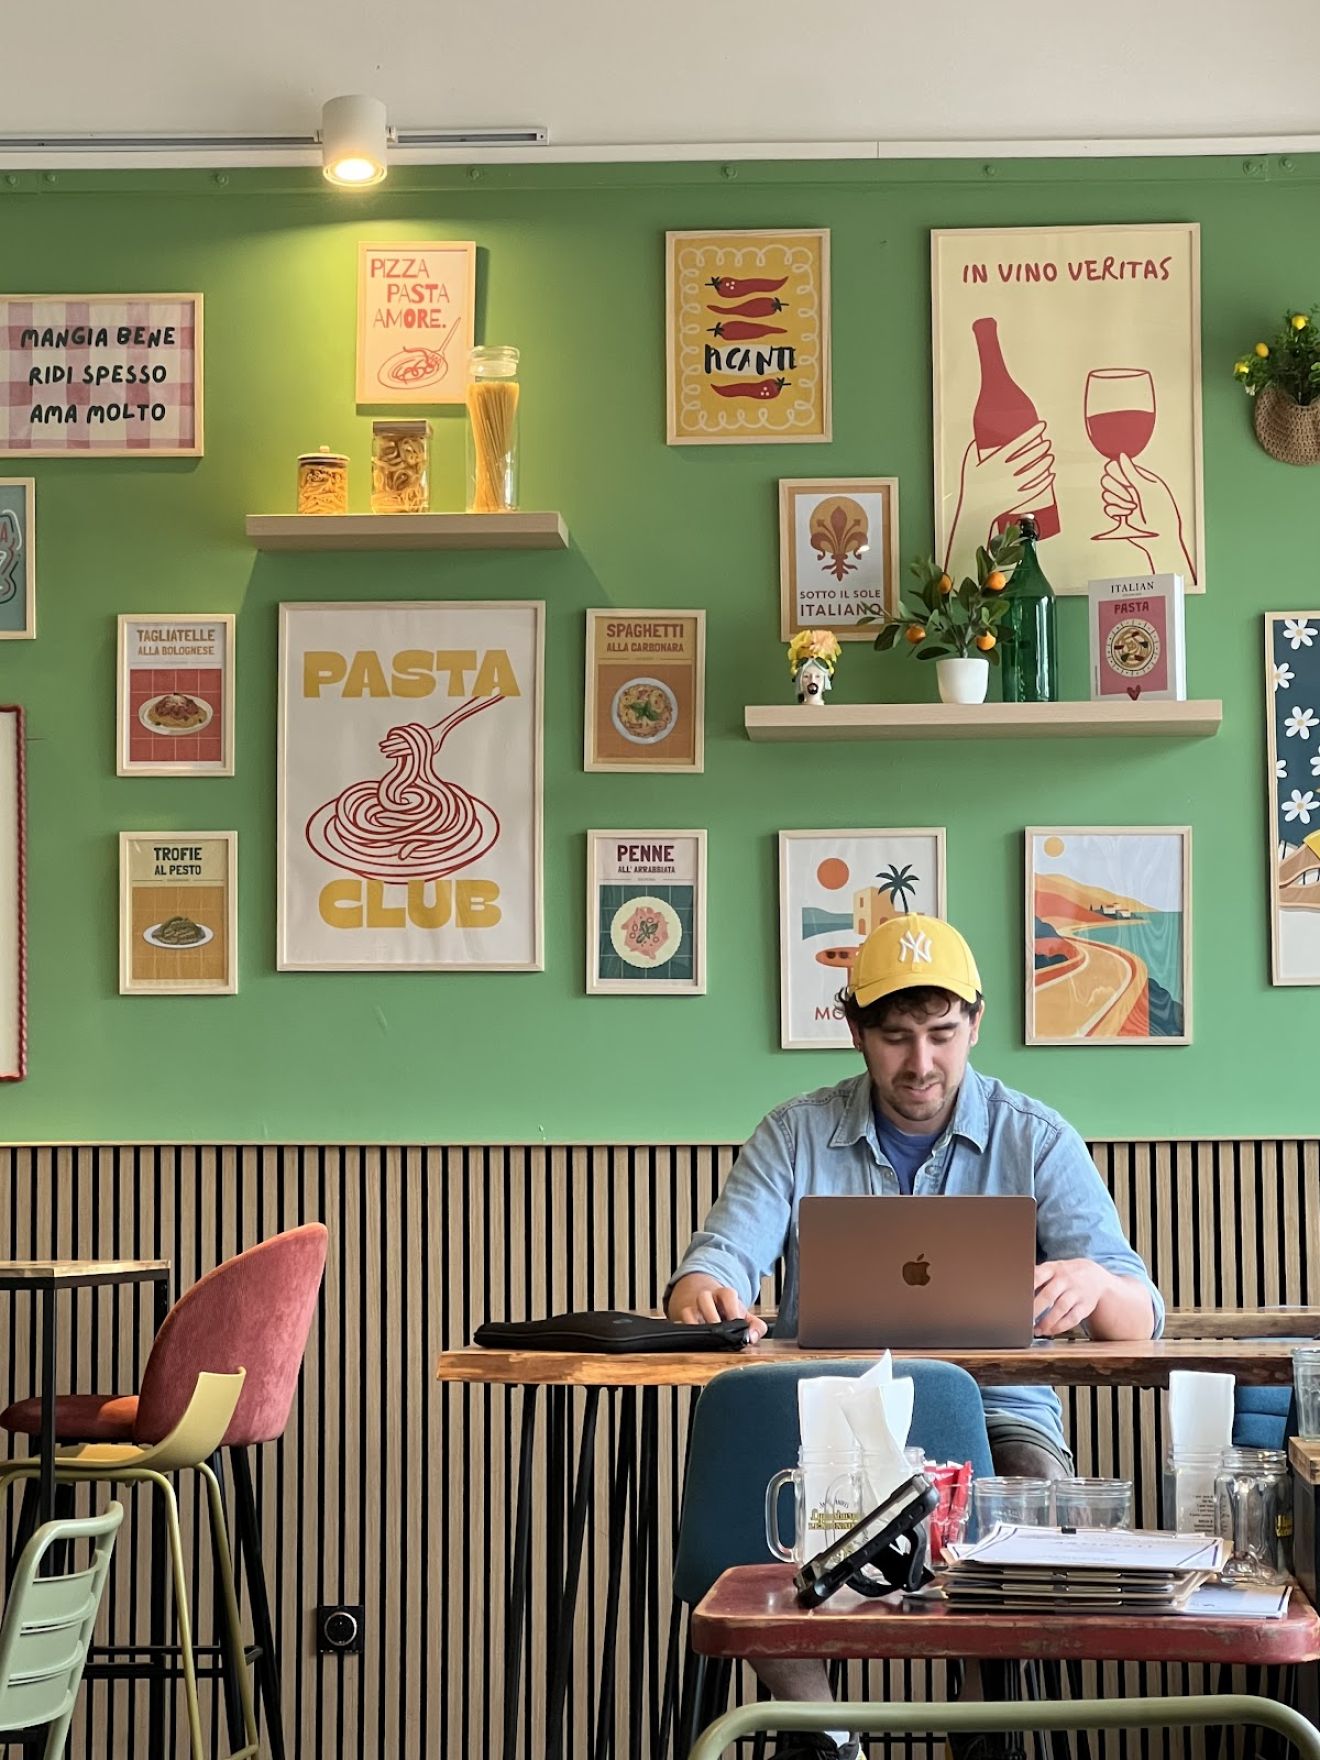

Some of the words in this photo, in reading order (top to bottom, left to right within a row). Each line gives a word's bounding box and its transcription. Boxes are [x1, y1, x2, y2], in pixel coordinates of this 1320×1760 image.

[370, 258, 430, 278] PIZZA
[963, 264, 988, 283] IN
[998, 262, 1058, 283] VINO
[1068, 256, 1172, 281] VERITAS
[387, 283, 450, 304] PASTA
[373, 308, 446, 329] AMORE.
[20, 326, 108, 349] MANGIA
[117, 326, 176, 349] BENE
[29, 366, 73, 386] RIDI
[82, 365, 167, 386] SPESSO
[30, 404, 77, 424] AMA
[86, 403, 166, 424] MOLTO
[800, 590, 837, 600] SOTTO
[840, 590, 850, 599] IL
[853, 589, 881, 599] SOLE
[1111, 581, 1155, 594] ITALIAN
[1114, 601, 1150, 615] PASTA
[137, 629, 216, 643] TAGLIATELLE
[606, 623, 684, 639] SPAGHETTI
[138, 646, 160, 656] ALLA
[162, 646, 215, 656] BOLOGNESE
[607, 643, 629, 652] ALLA
[631, 643, 684, 653] CARBONARA
[303, 650, 521, 698] PASTA
[153, 847, 203, 861] TROFIE
[617, 845, 675, 863] PENNE
[155, 865, 167, 876] AL
[169, 865, 201, 876] PESTO
[318, 879, 502, 929] CLUB
